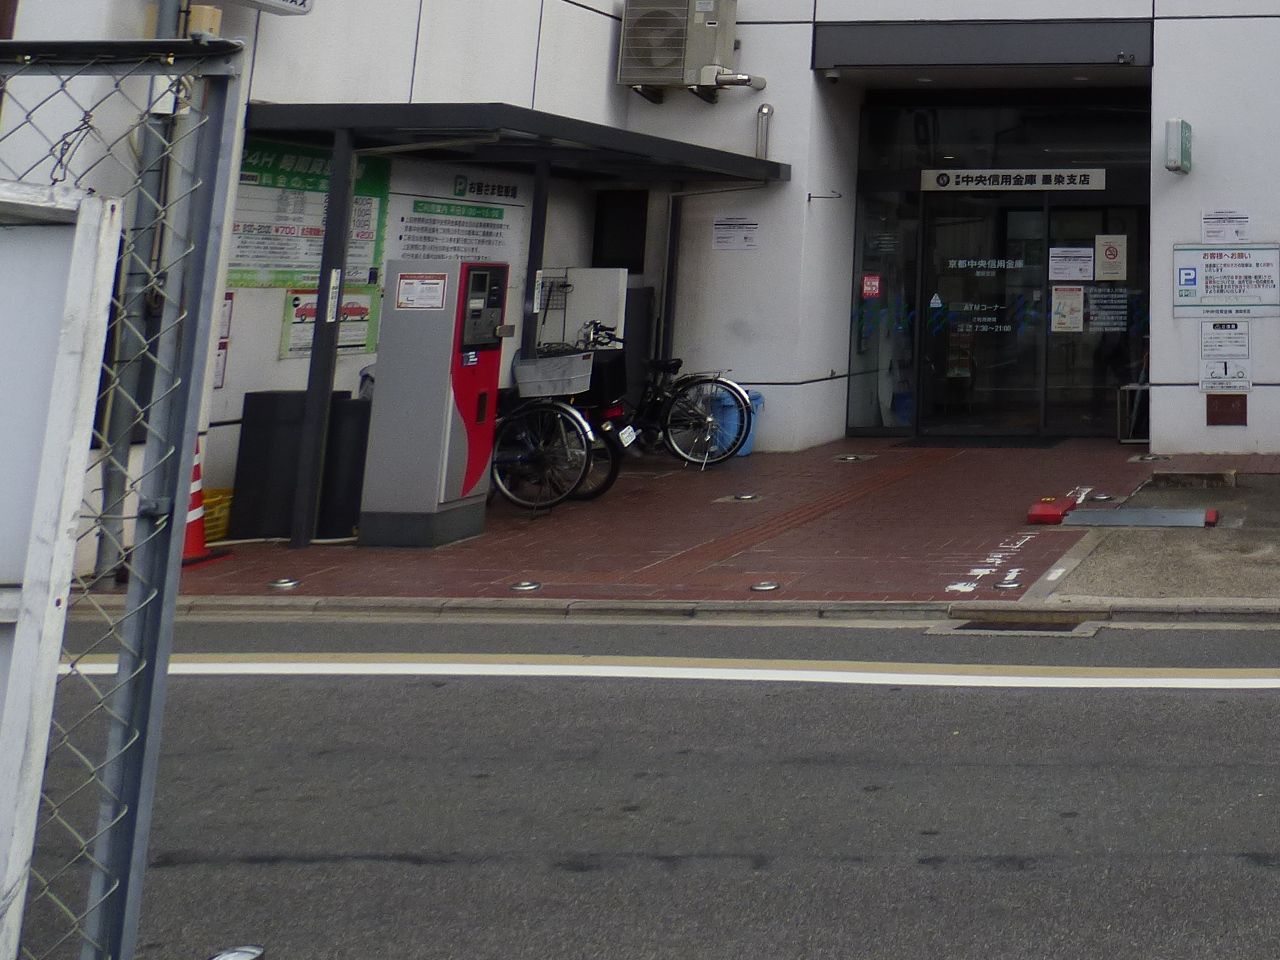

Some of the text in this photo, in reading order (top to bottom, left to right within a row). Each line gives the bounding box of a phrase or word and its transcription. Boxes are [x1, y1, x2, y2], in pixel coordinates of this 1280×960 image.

[962, 173, 1037, 187] 中央信用金庫
[1042, 173, 1091, 186] 墨染支店
[1202, 252, 1251, 260] お客様へお願い
[948, 259, 1024, 269] 京都中央信用金庫
[963, 303, 1007, 311] ATMコーナー
